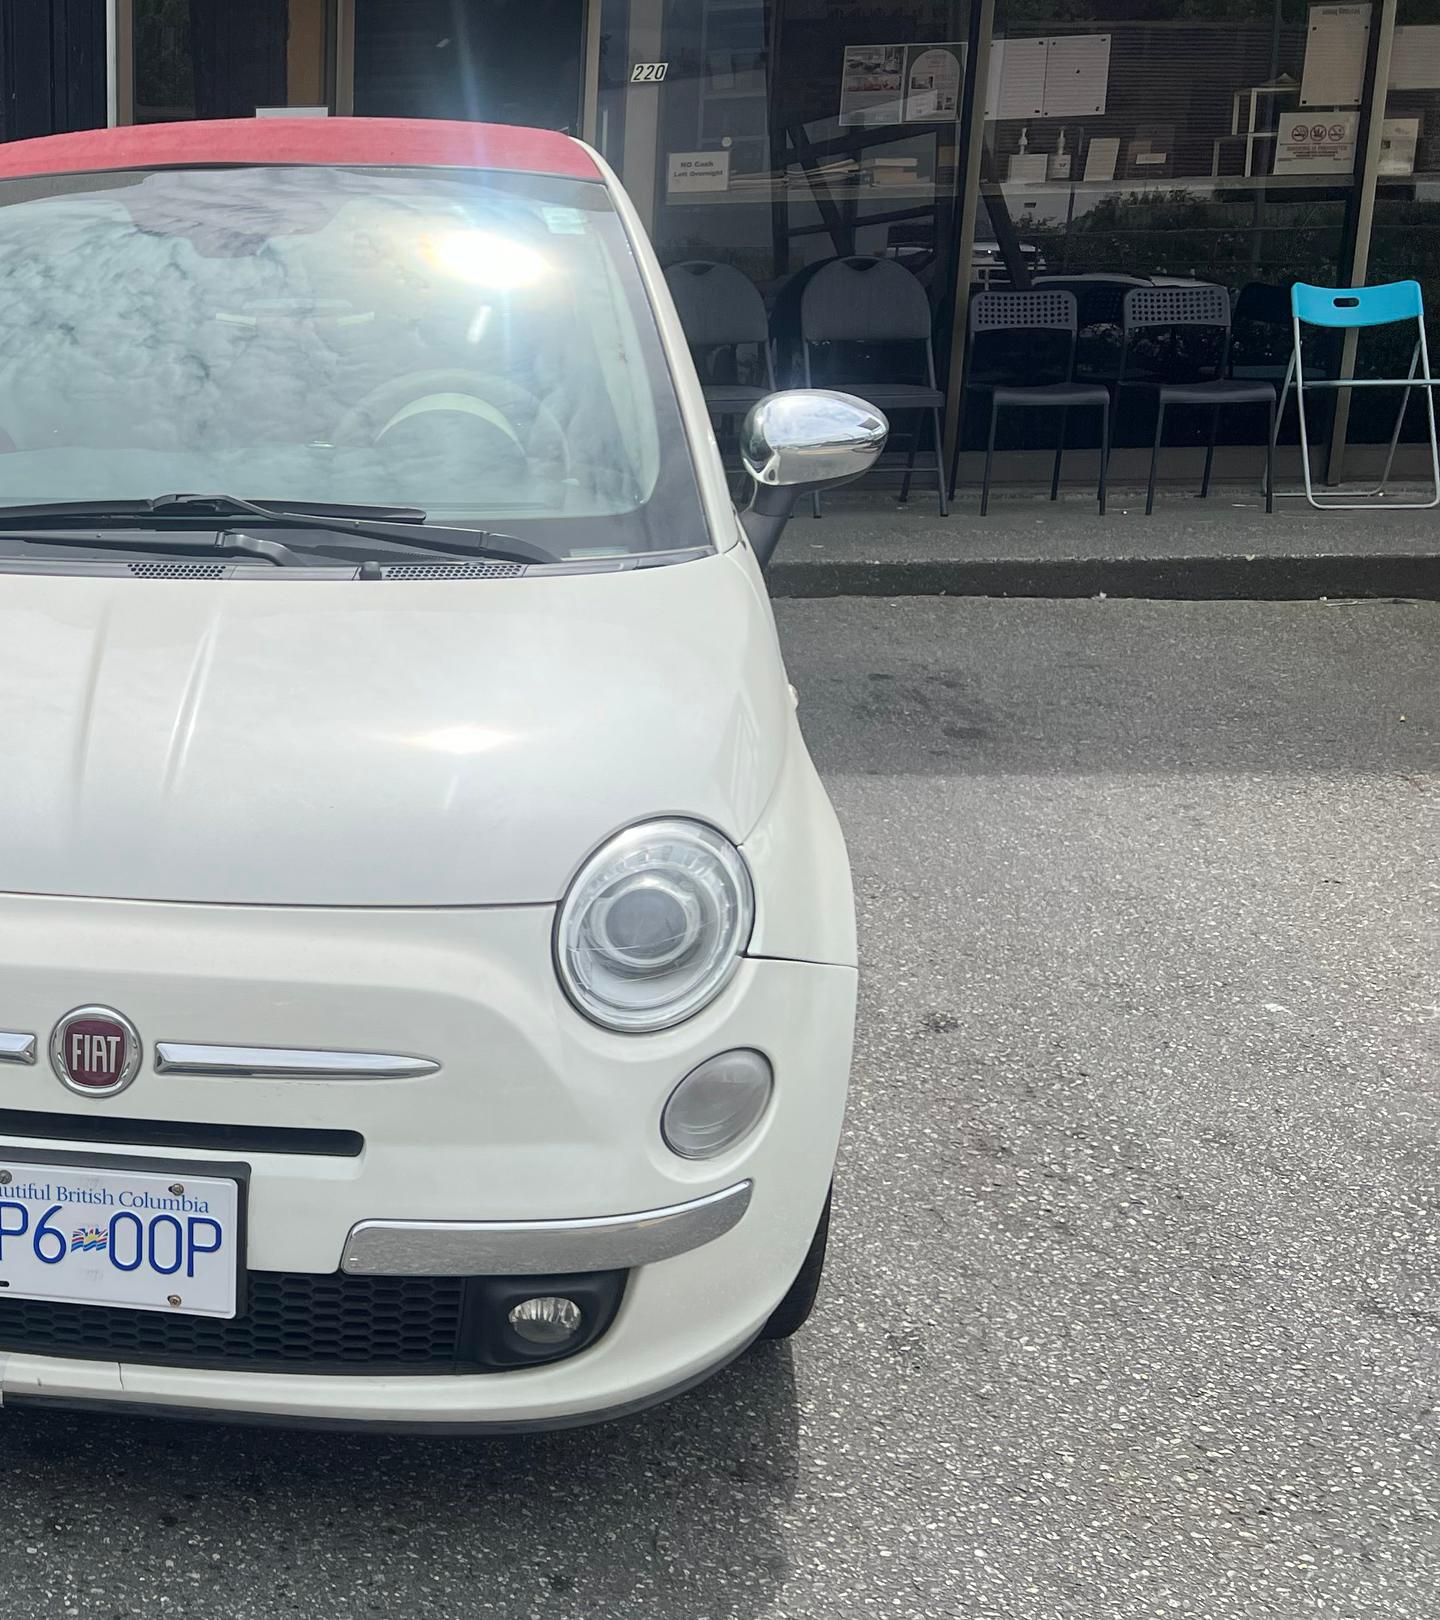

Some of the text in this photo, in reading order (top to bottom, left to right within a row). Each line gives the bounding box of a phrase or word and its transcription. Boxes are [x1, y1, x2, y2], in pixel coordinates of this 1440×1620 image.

[633, 64, 666, 81] 220
[72, 1034, 121, 1073] FIAT
[56, 1186, 114, 1206] British
[118, 1191, 209, 1214] Columbia
